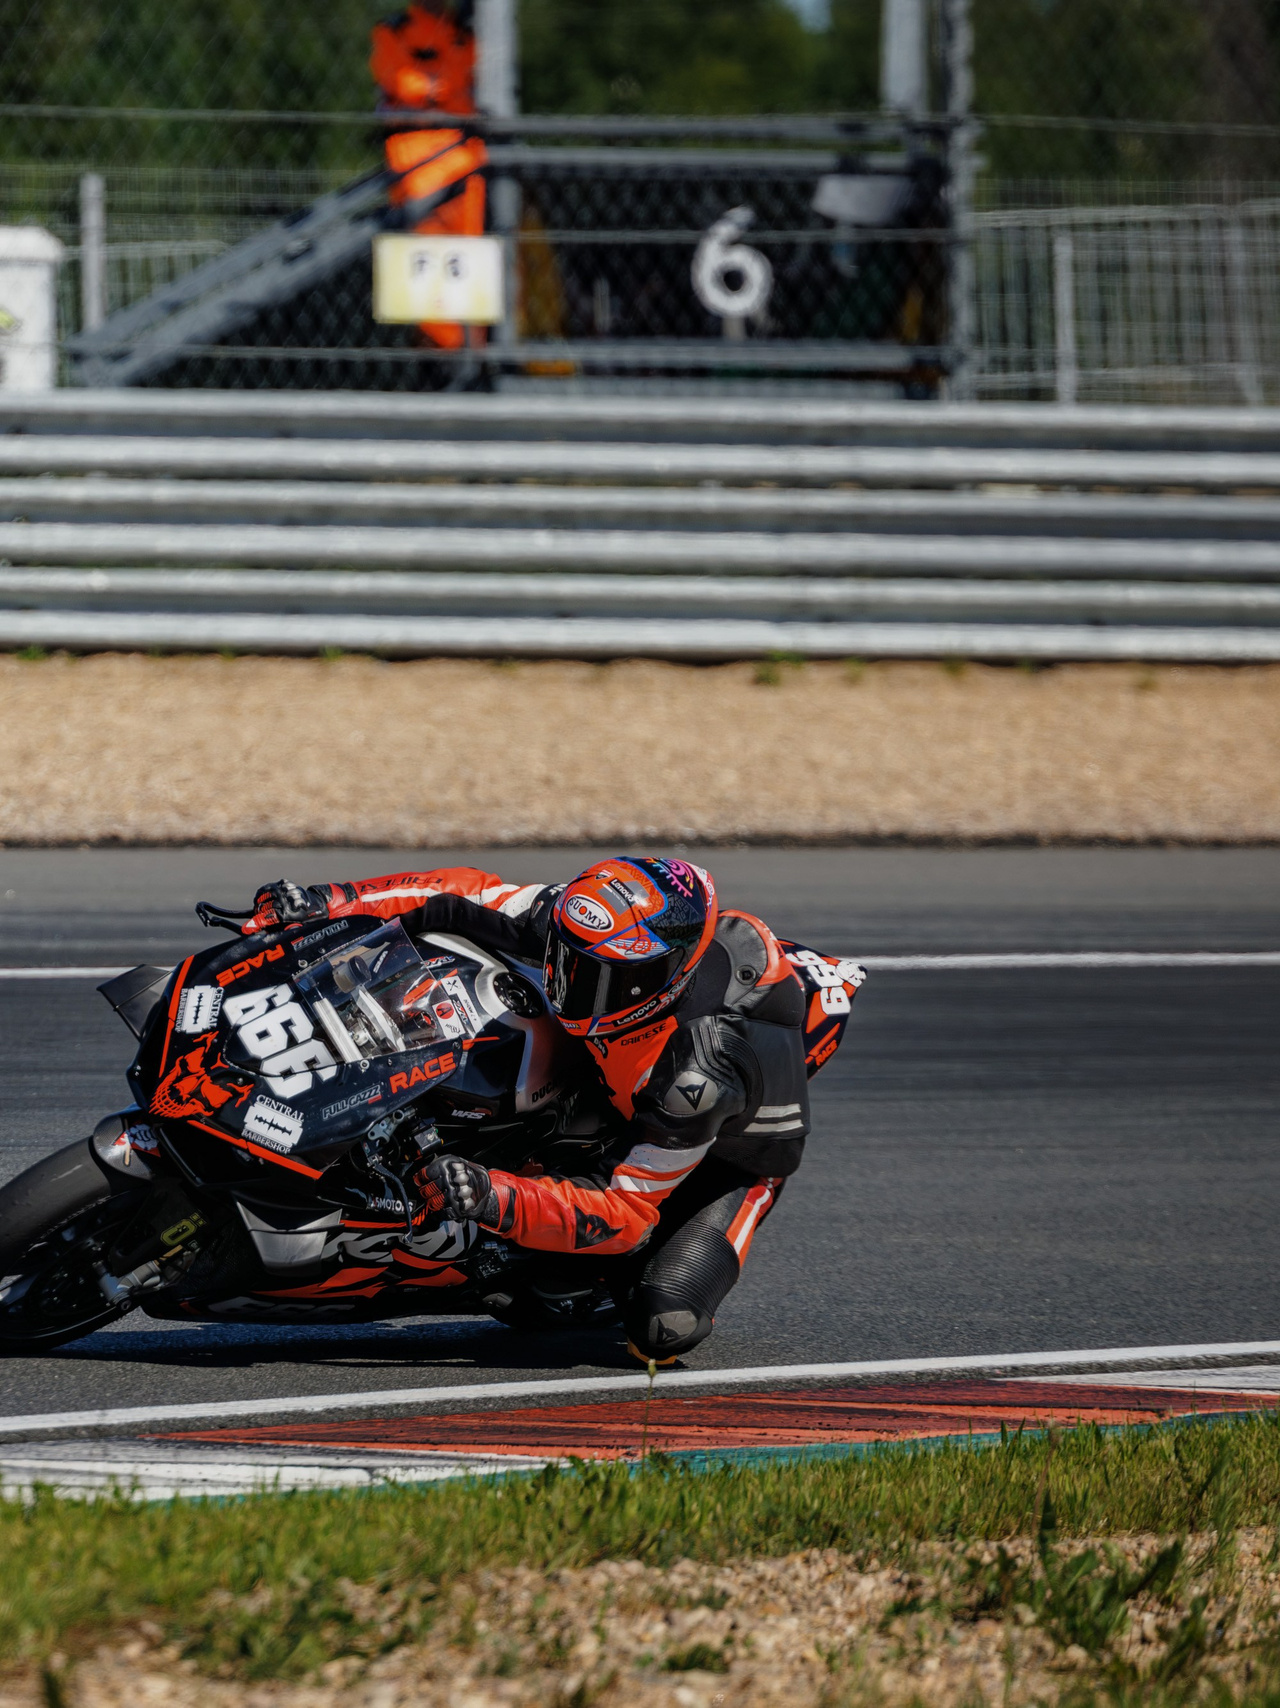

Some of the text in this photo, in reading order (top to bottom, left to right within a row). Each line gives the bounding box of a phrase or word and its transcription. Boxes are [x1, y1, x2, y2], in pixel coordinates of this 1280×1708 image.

[690, 205, 774, 318] 6
[611, 878, 635, 903] Lenovo
[569, 897, 609, 930] SUOMY
[216, 944, 285, 987] RACE
[207, 986, 224, 1029] CENTRAL
[617, 1000, 657, 1025] Lenovo
[222, 983, 339, 1099] 666
[621, 1023, 666, 1046] DAINESE
[815, 1040, 838, 1066] RACE
[389, 1051, 457, 1094] RACE
[256, 1094, 305, 1121] CENTRAL
[322, 1101, 349, 1120] FULL
[241, 1128, 291, 1155] BARBERSHOP
